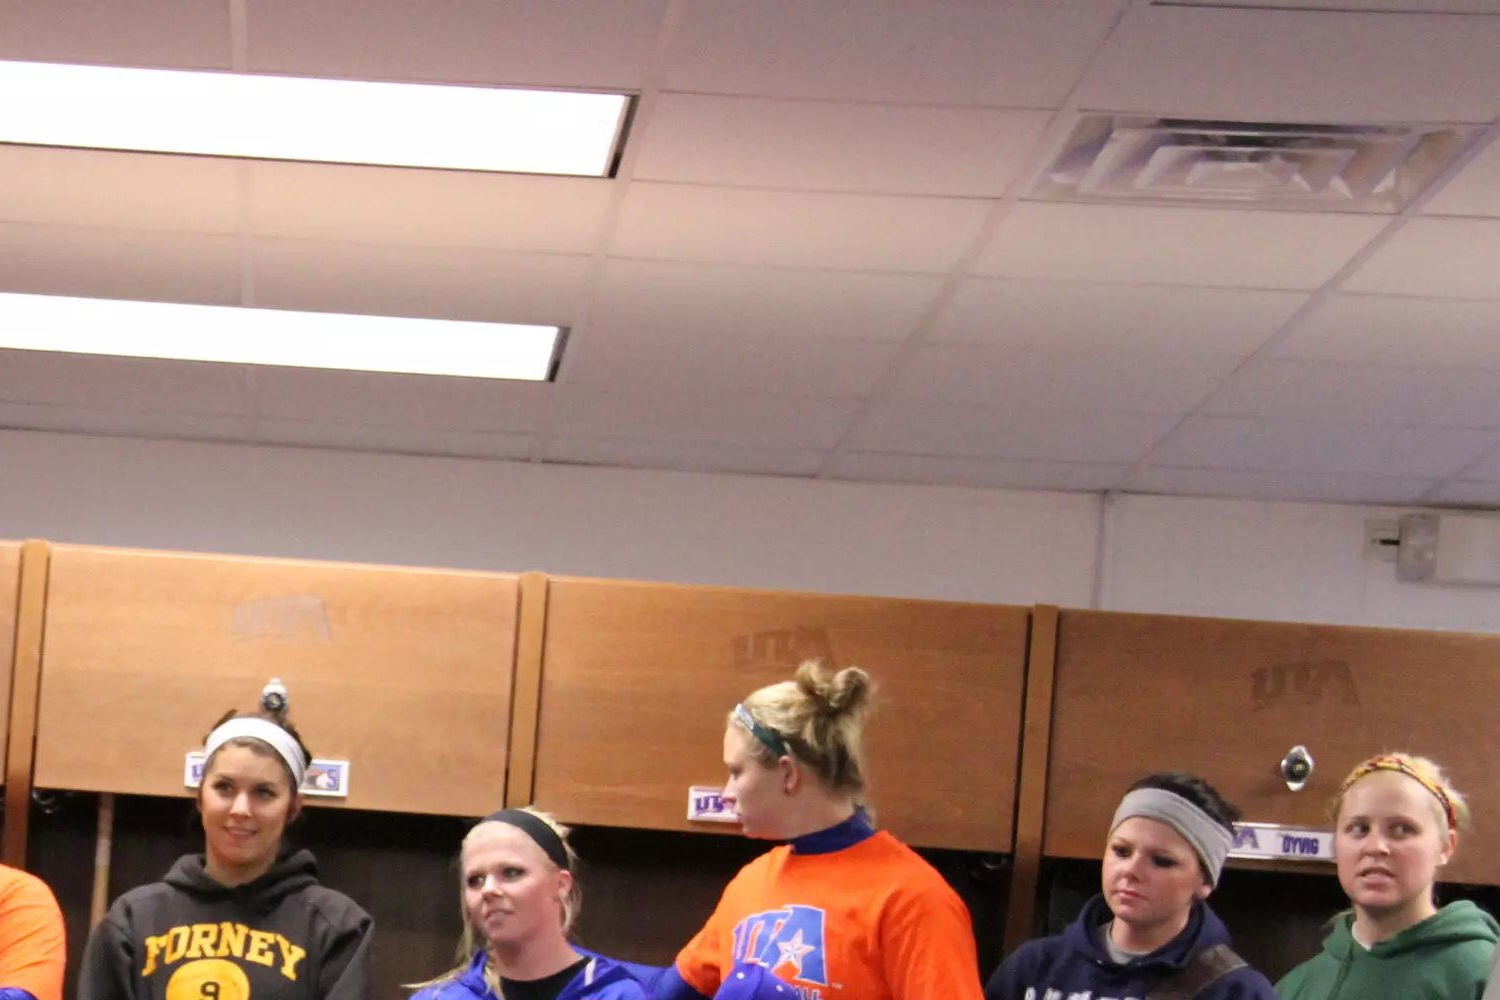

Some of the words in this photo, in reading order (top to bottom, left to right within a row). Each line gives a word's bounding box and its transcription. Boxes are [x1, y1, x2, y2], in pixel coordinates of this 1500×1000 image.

[1251, 658, 1361, 710] UTA
[694, 795, 725, 815] UT
[141, 922, 307, 982] FORNEY
